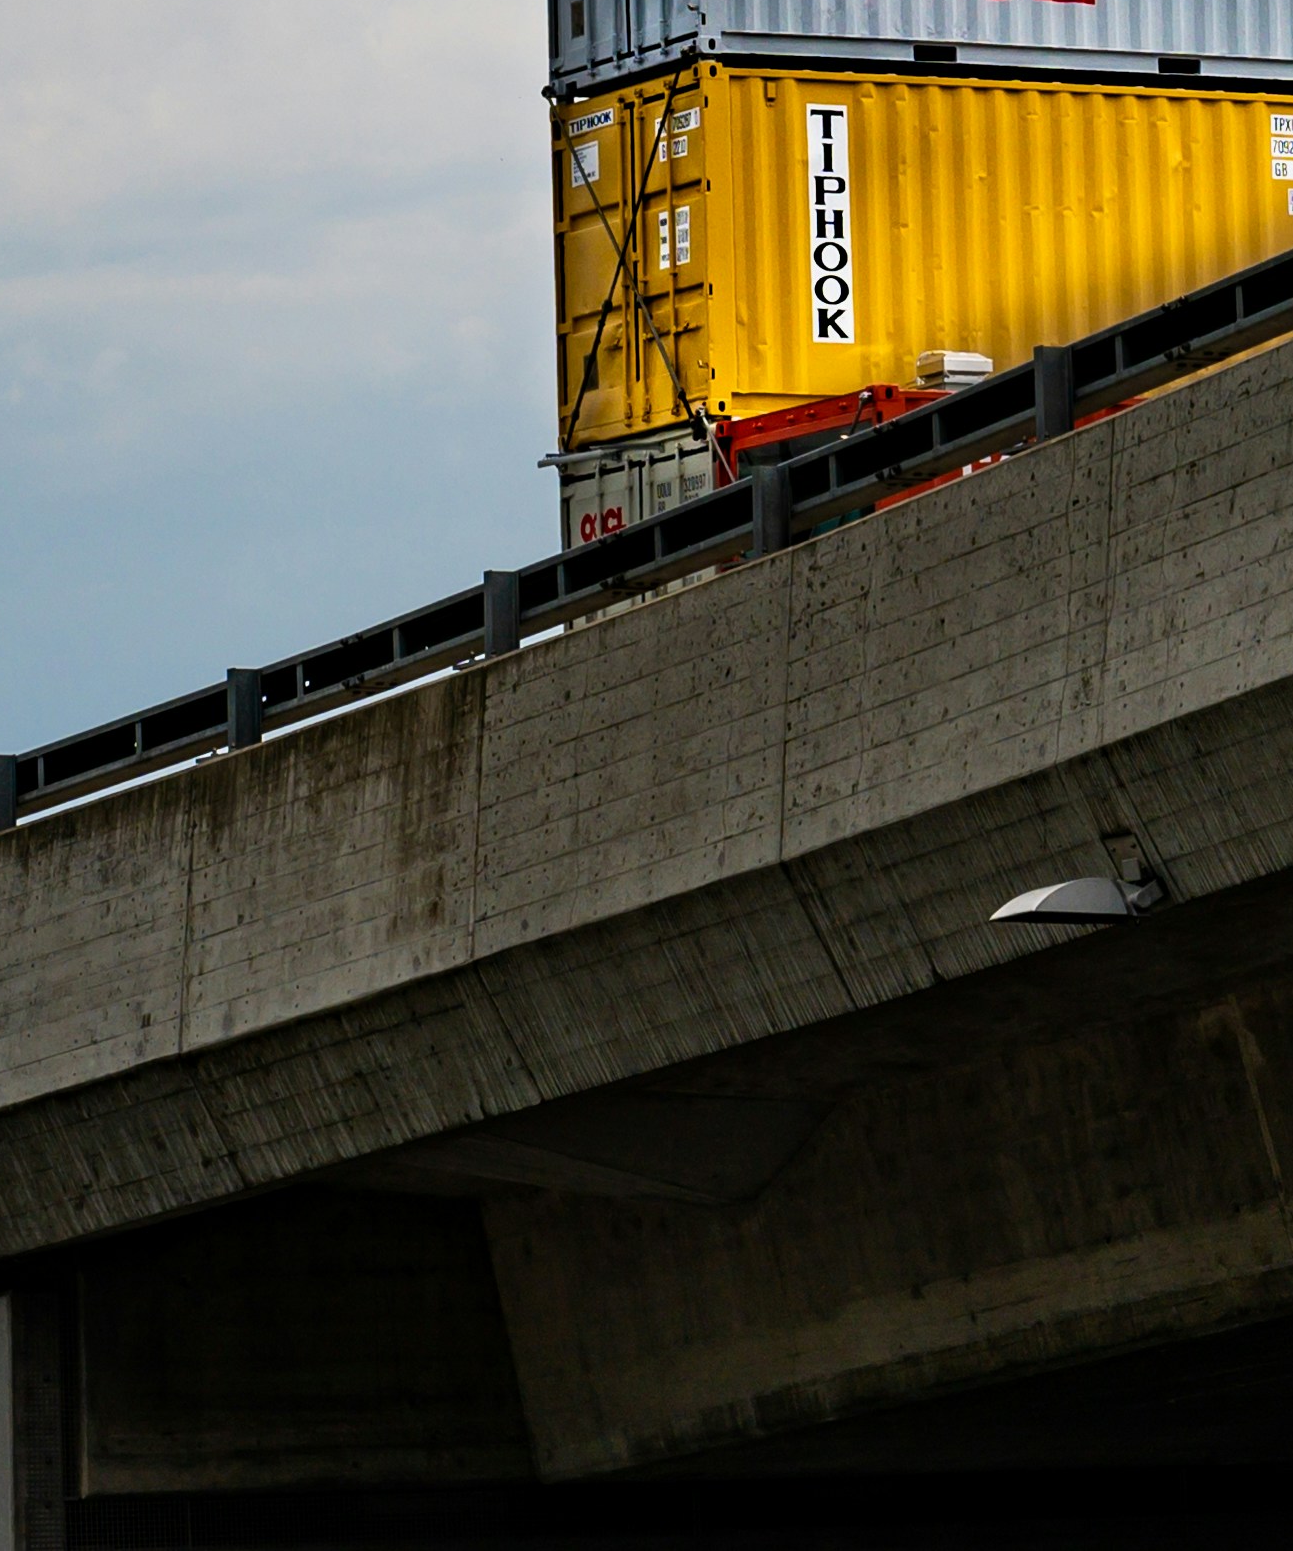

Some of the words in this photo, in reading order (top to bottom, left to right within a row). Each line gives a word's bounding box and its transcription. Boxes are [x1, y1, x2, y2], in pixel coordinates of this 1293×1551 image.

[570, 111, 612, 134] TIPHOOK
[1275, 163, 1287, 177] GB
[810, 109, 849, 338] TIPHOOK
